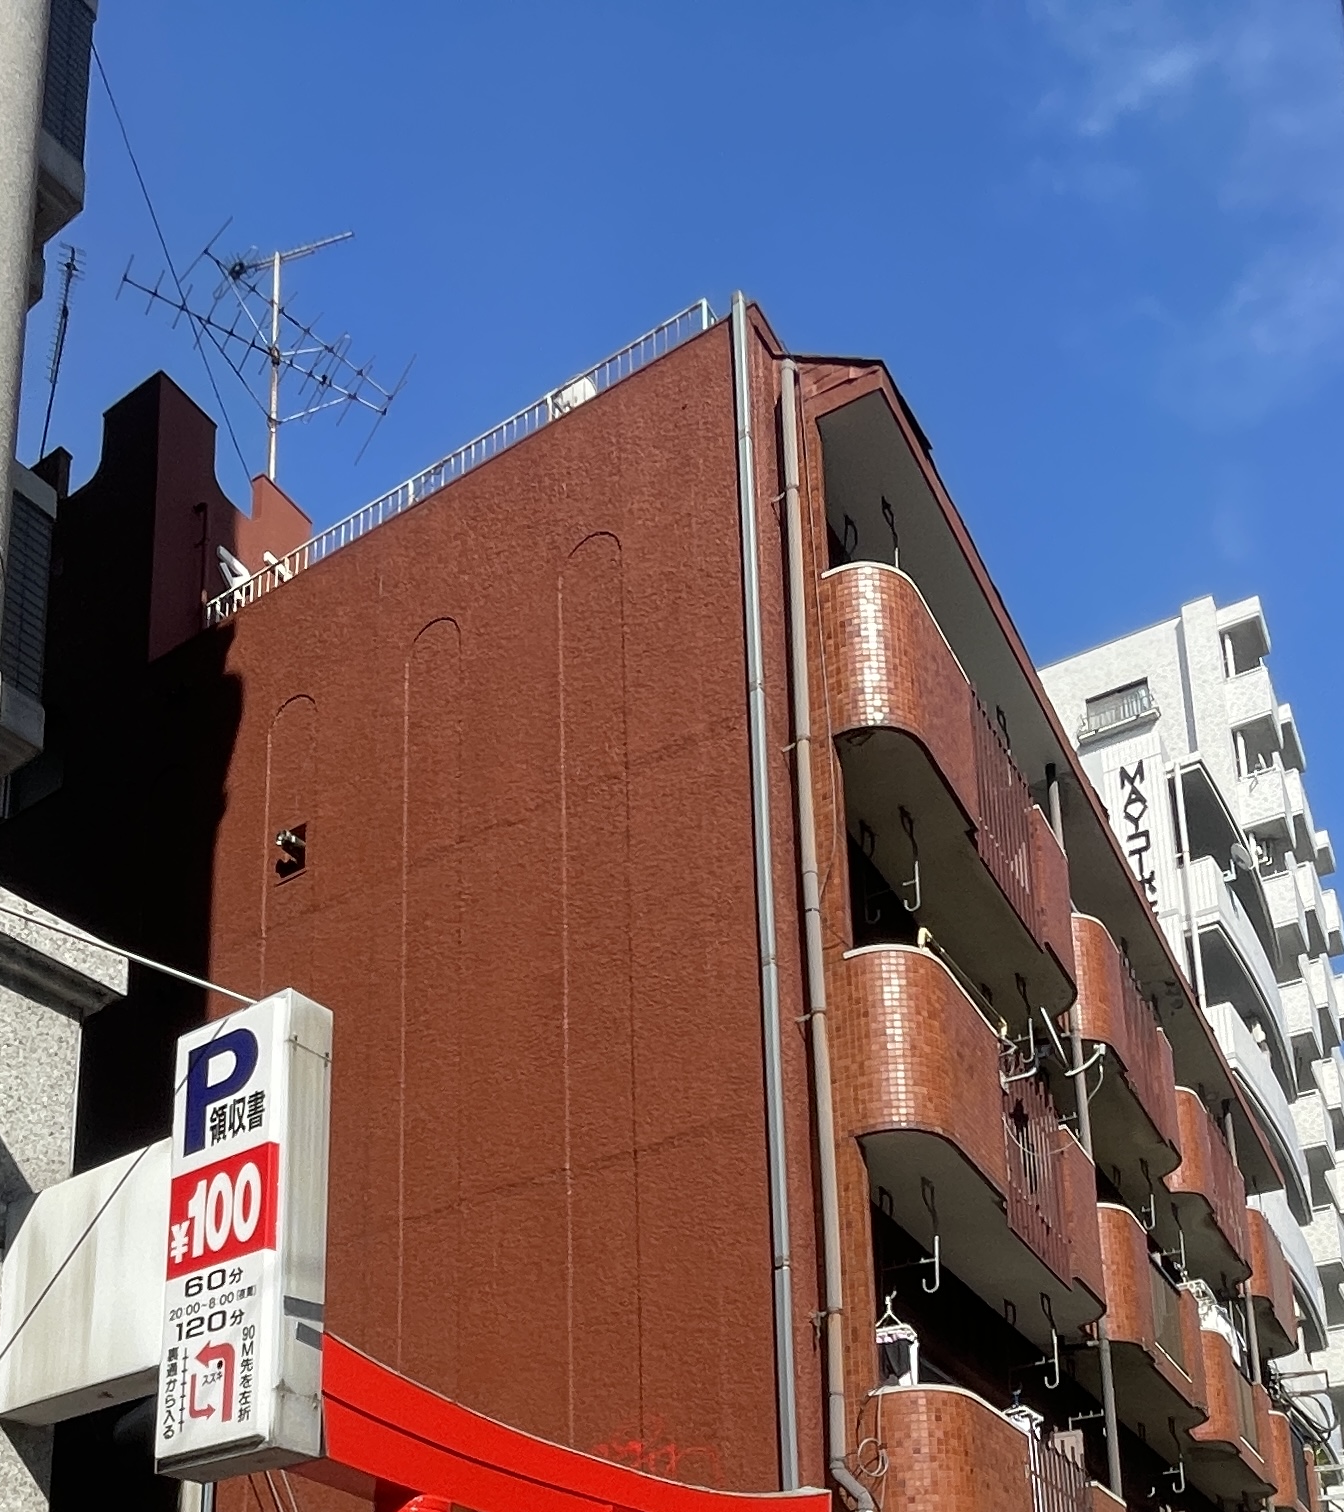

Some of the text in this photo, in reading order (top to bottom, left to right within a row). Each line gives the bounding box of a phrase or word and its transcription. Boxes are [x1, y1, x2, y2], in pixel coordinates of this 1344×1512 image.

[183, 1028, 259, 1158] P
[209, 1090, 266, 1147] 領収書
[169, 1162, 262, 1264] ¥100
[184, 1267, 244, 1298] 60分
[176, 1308, 245, 1341] 120分
